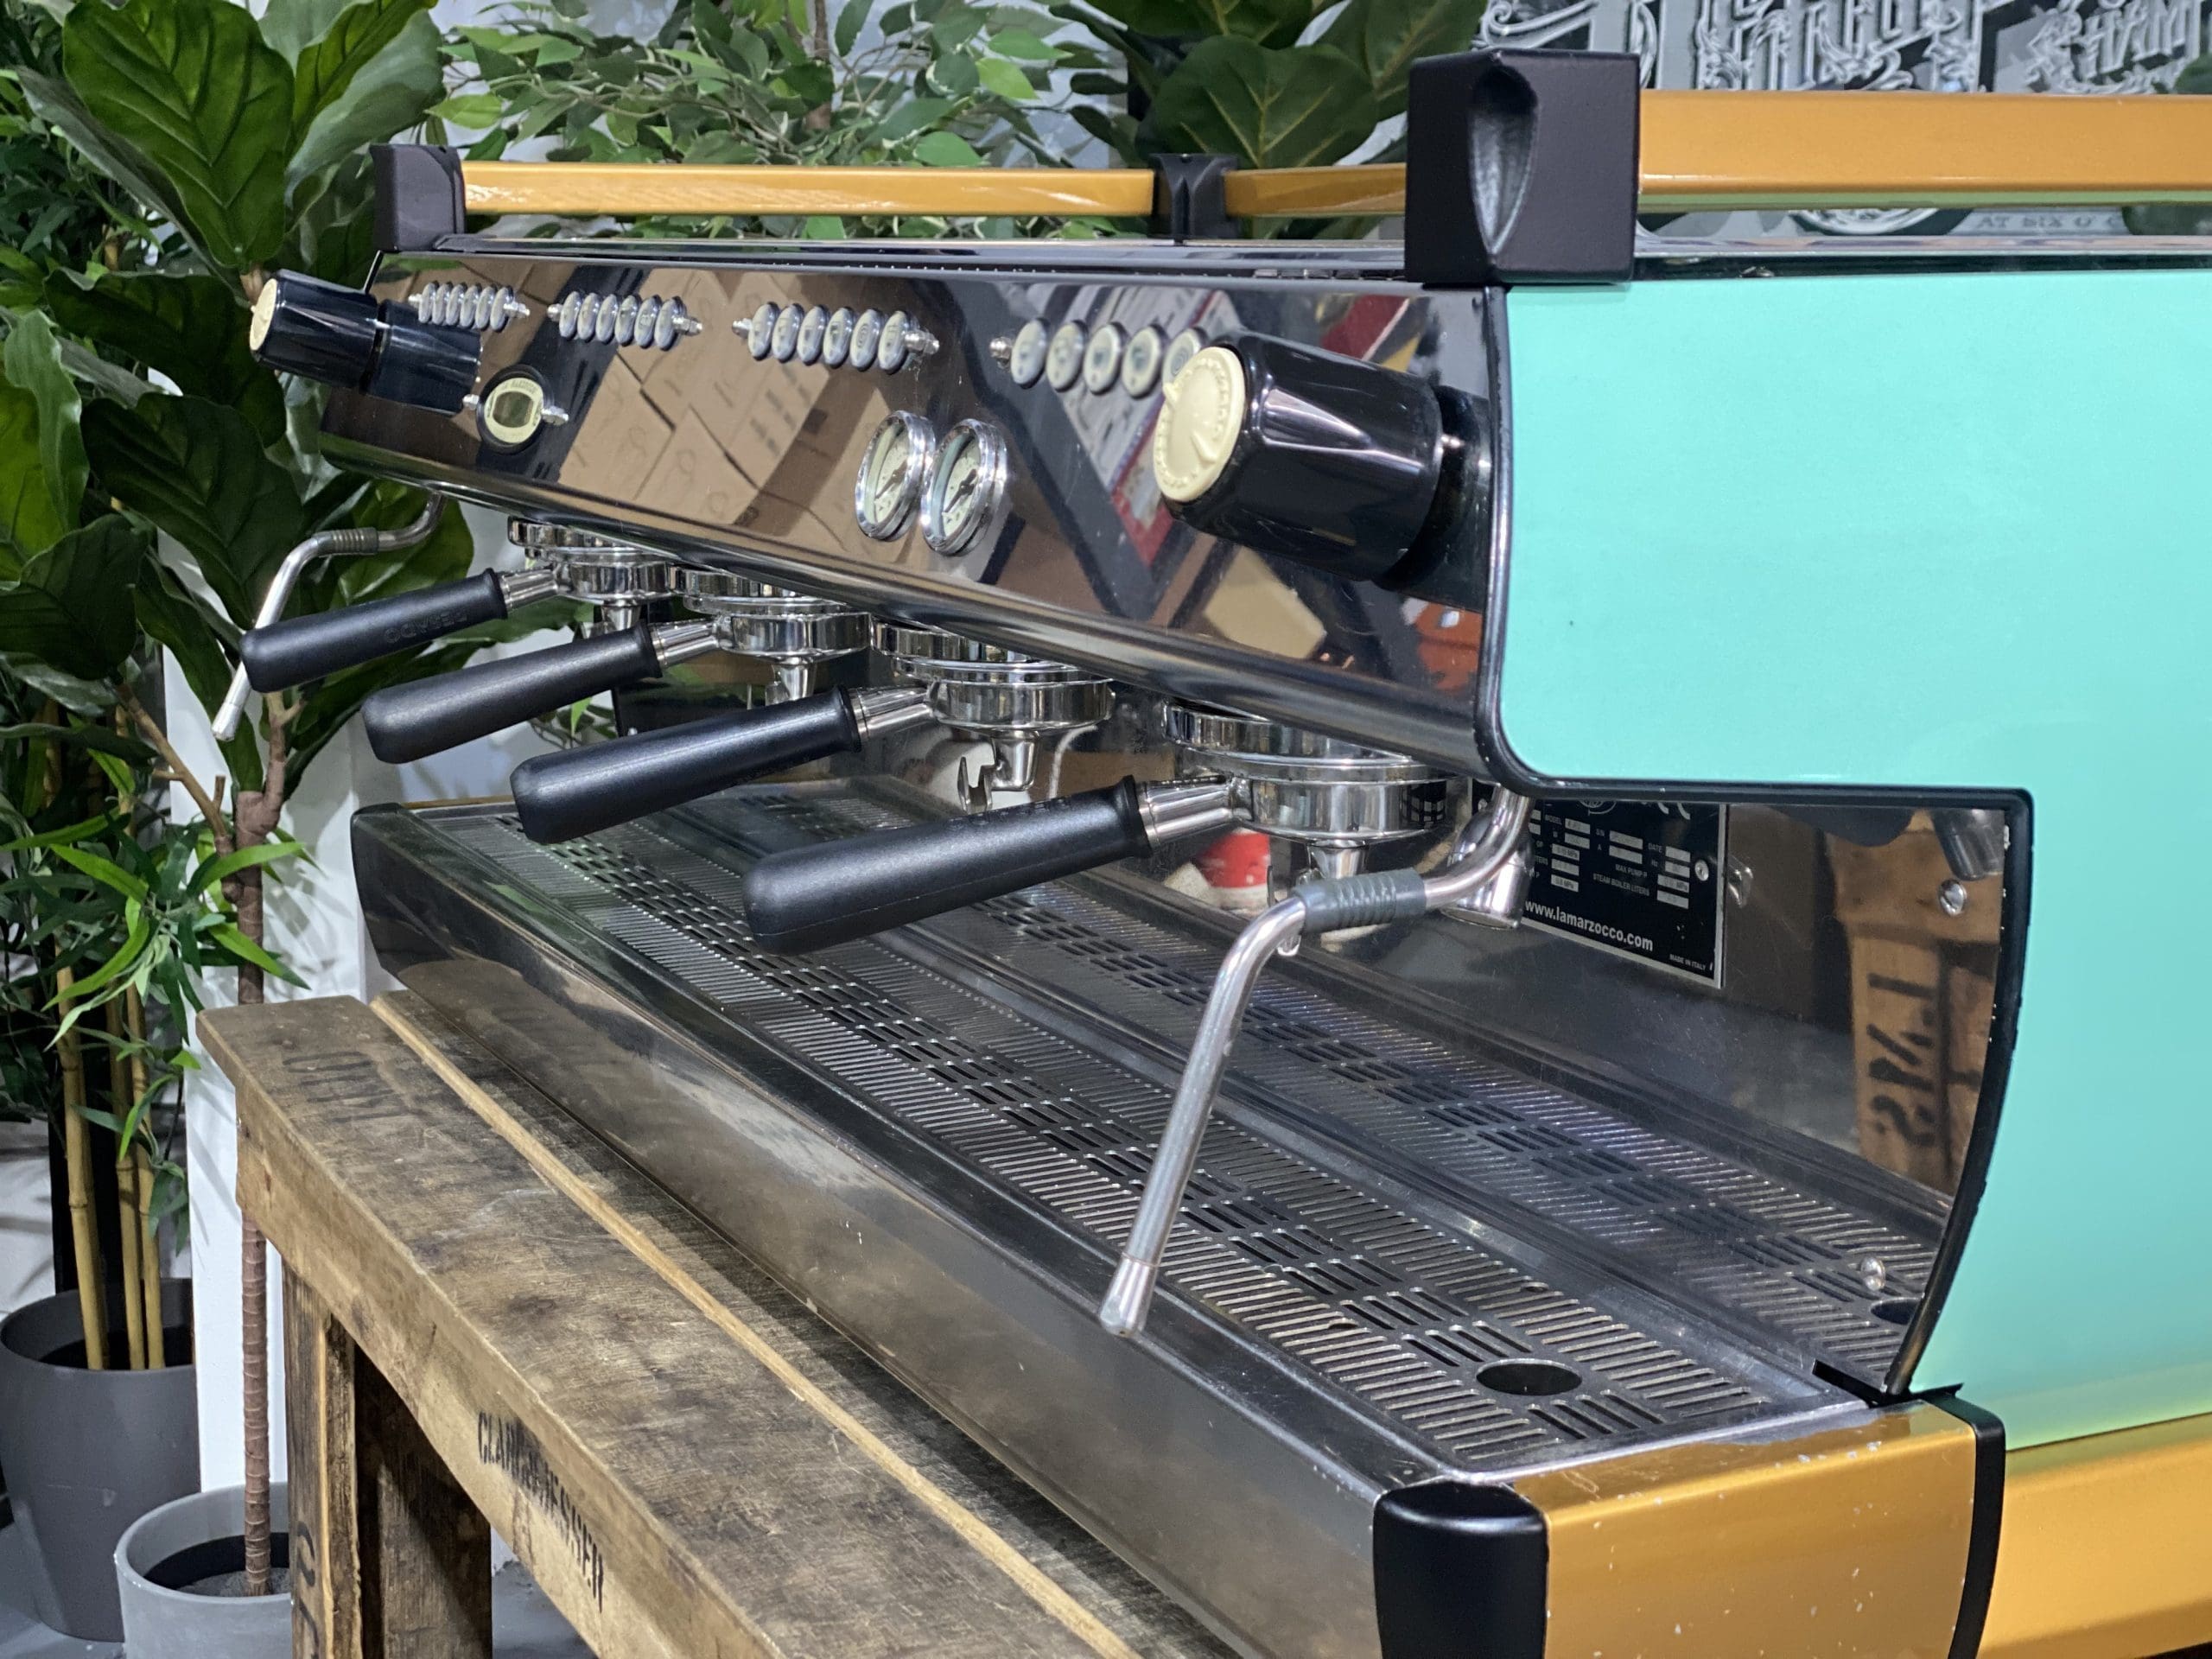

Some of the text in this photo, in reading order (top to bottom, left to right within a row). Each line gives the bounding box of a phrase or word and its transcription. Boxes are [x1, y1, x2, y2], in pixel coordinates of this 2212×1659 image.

[1648, 842, 1662, 853] DATE
[1593, 873, 1611, 885] STEAM
[1611, 878, 1630, 891] BOILER
[1525, 900, 1654, 951] www.lamarzocco.com
[1669, 954, 1684, 963] MADE
[1691, 961, 1707, 971] ITALY
